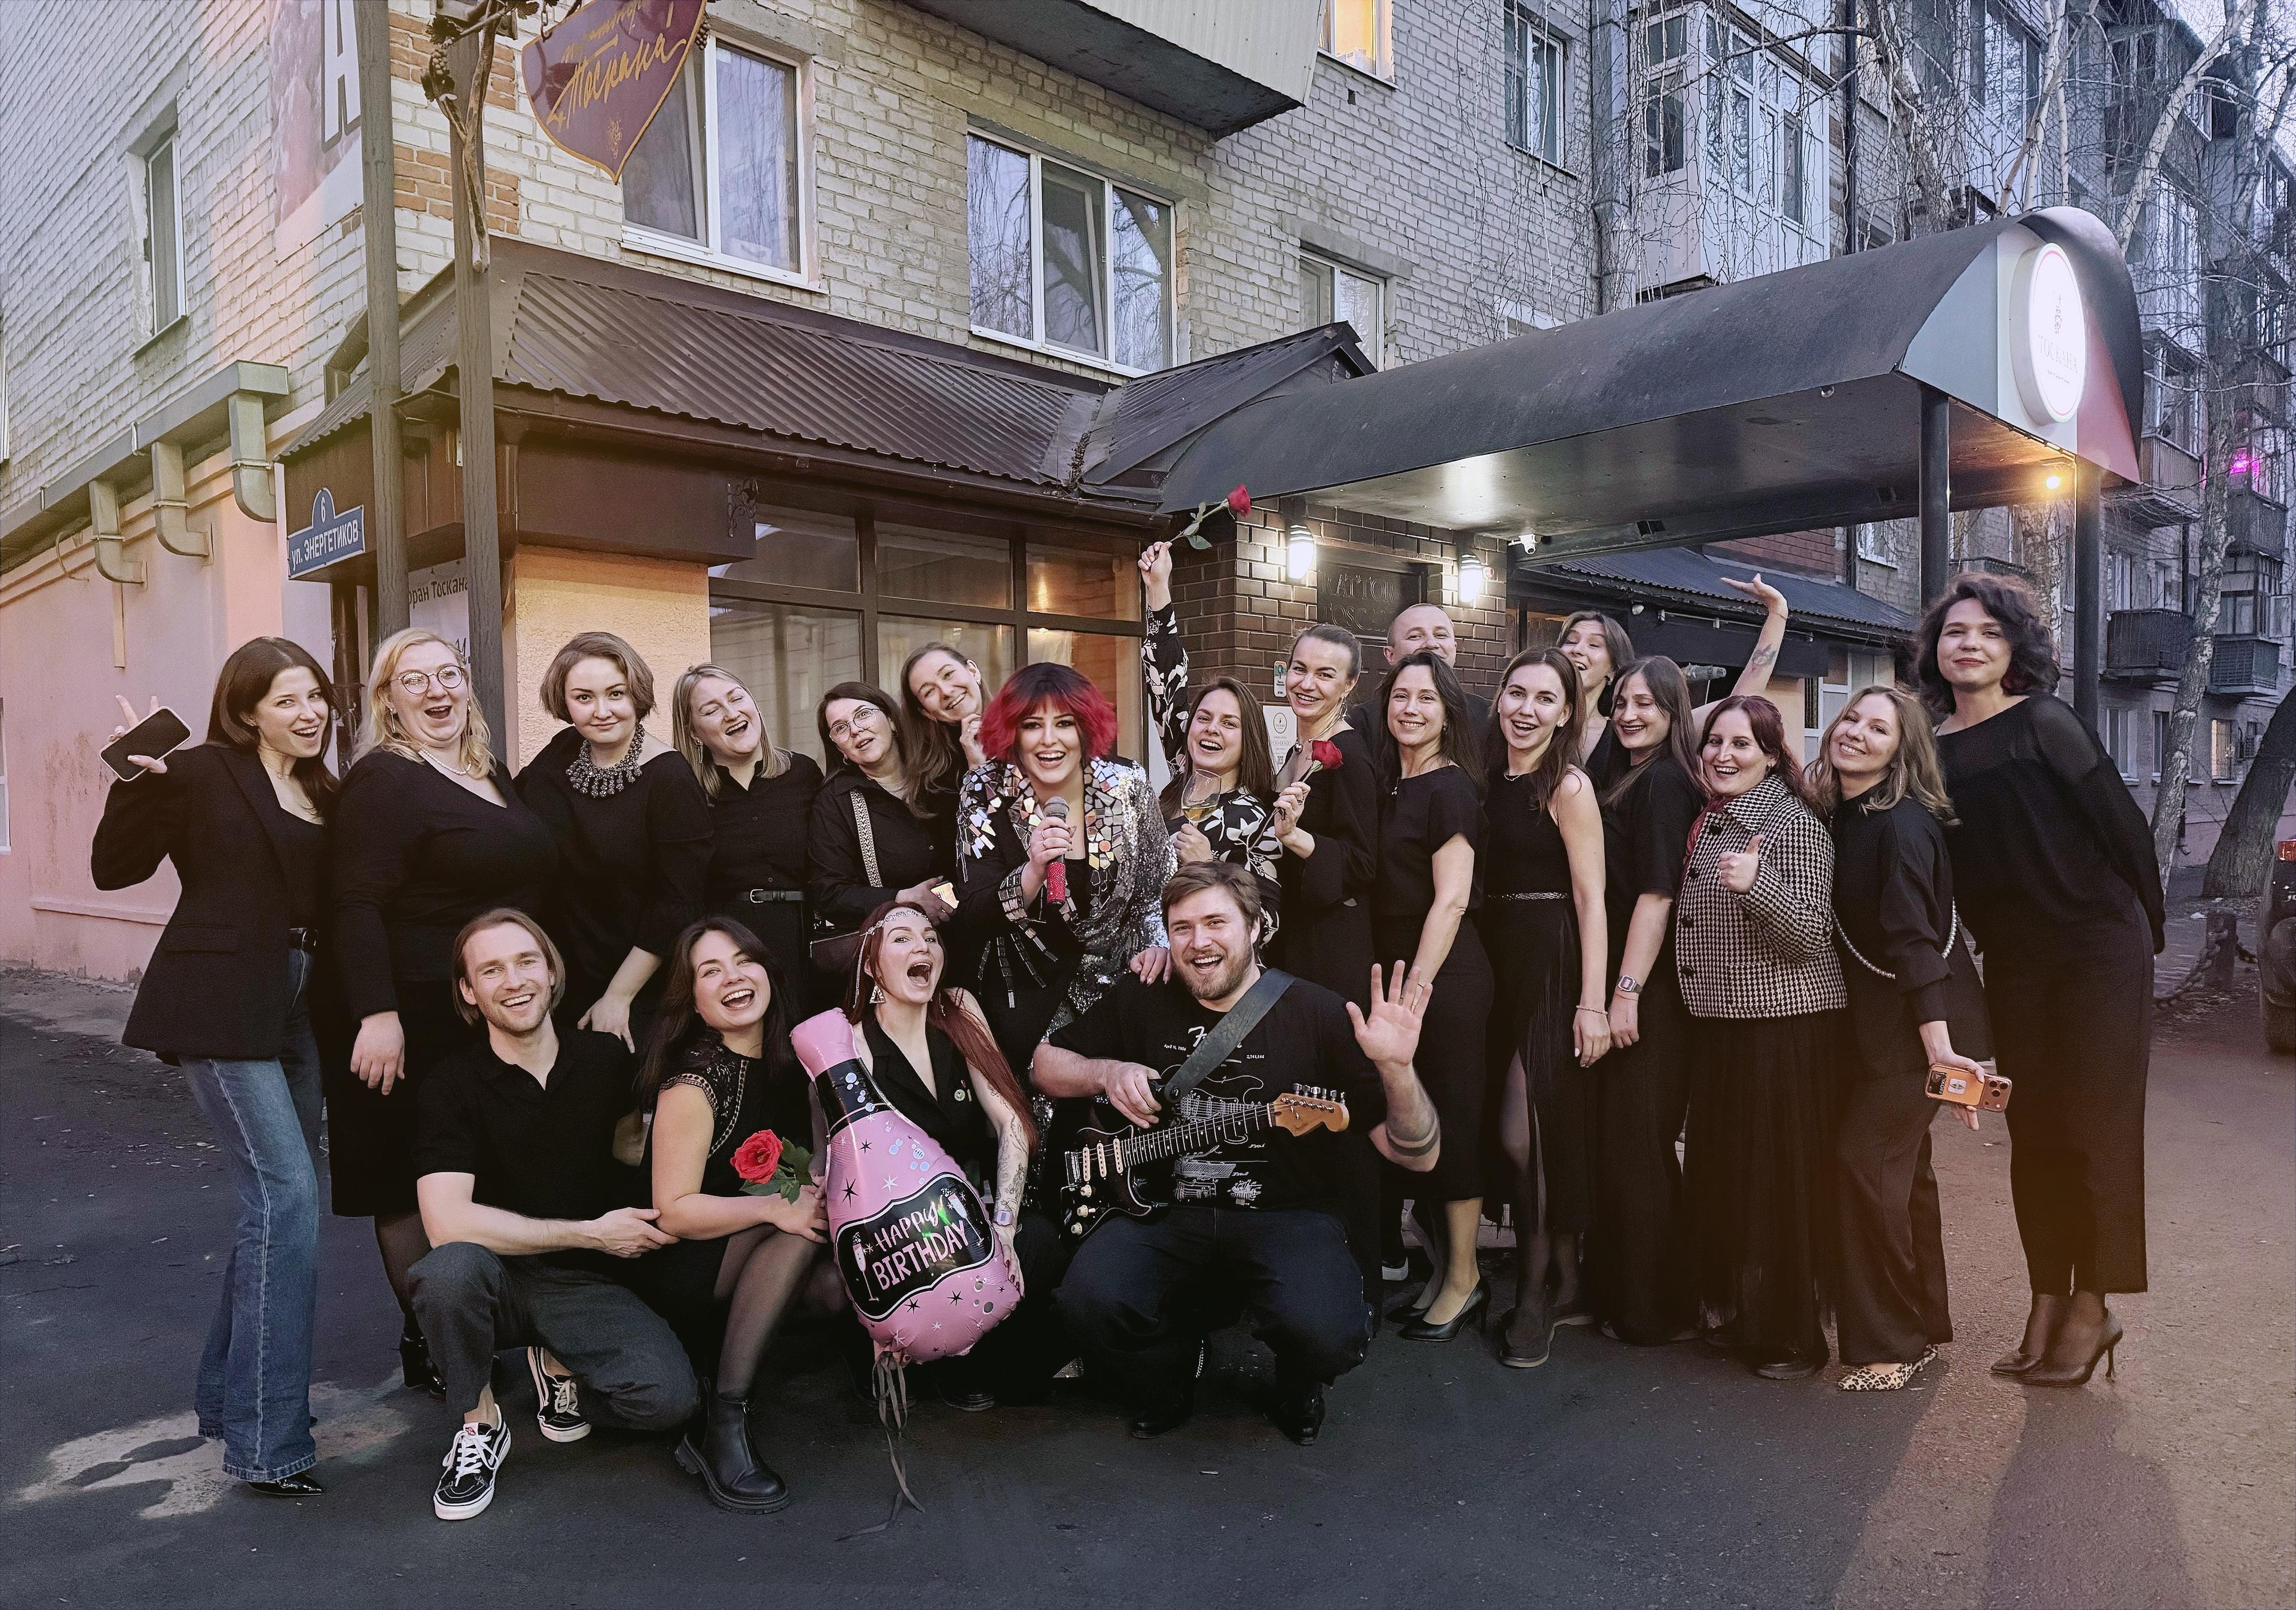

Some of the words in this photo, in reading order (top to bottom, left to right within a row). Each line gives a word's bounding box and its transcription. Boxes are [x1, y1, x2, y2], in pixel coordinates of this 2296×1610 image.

[320, 496, 326, 523] 6
[291, 548, 303, 571] ул.
[304, 519, 359, 561] ЭНЕРГЕТИКОВ
[872, 1220, 969, 1290] BIRTHDAY
